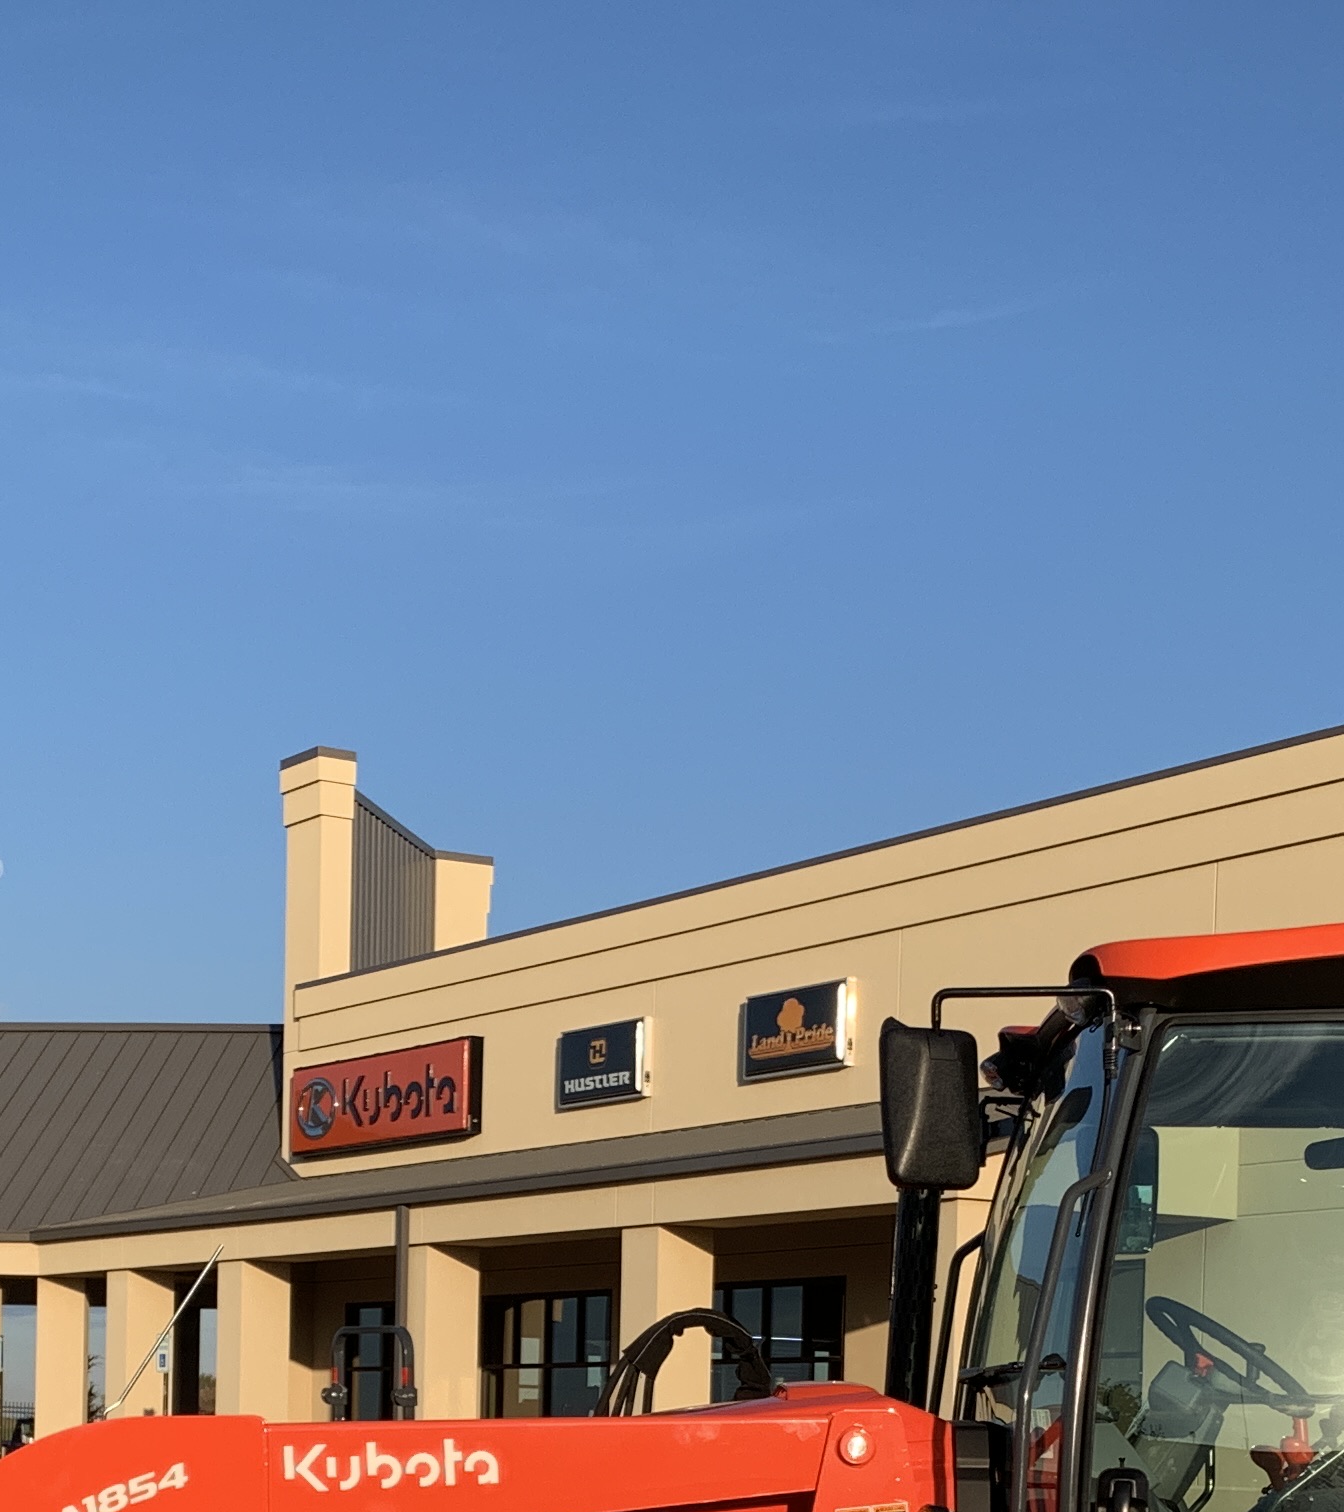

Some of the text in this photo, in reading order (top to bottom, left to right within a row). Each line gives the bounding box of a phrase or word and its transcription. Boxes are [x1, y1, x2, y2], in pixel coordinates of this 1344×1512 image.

[795, 1023, 834, 1041] Pride
[341, 1063, 456, 1127] Kubota
[564, 1071, 630, 1094] HUSTLER
[283, 1438, 499, 1492] Kubota
